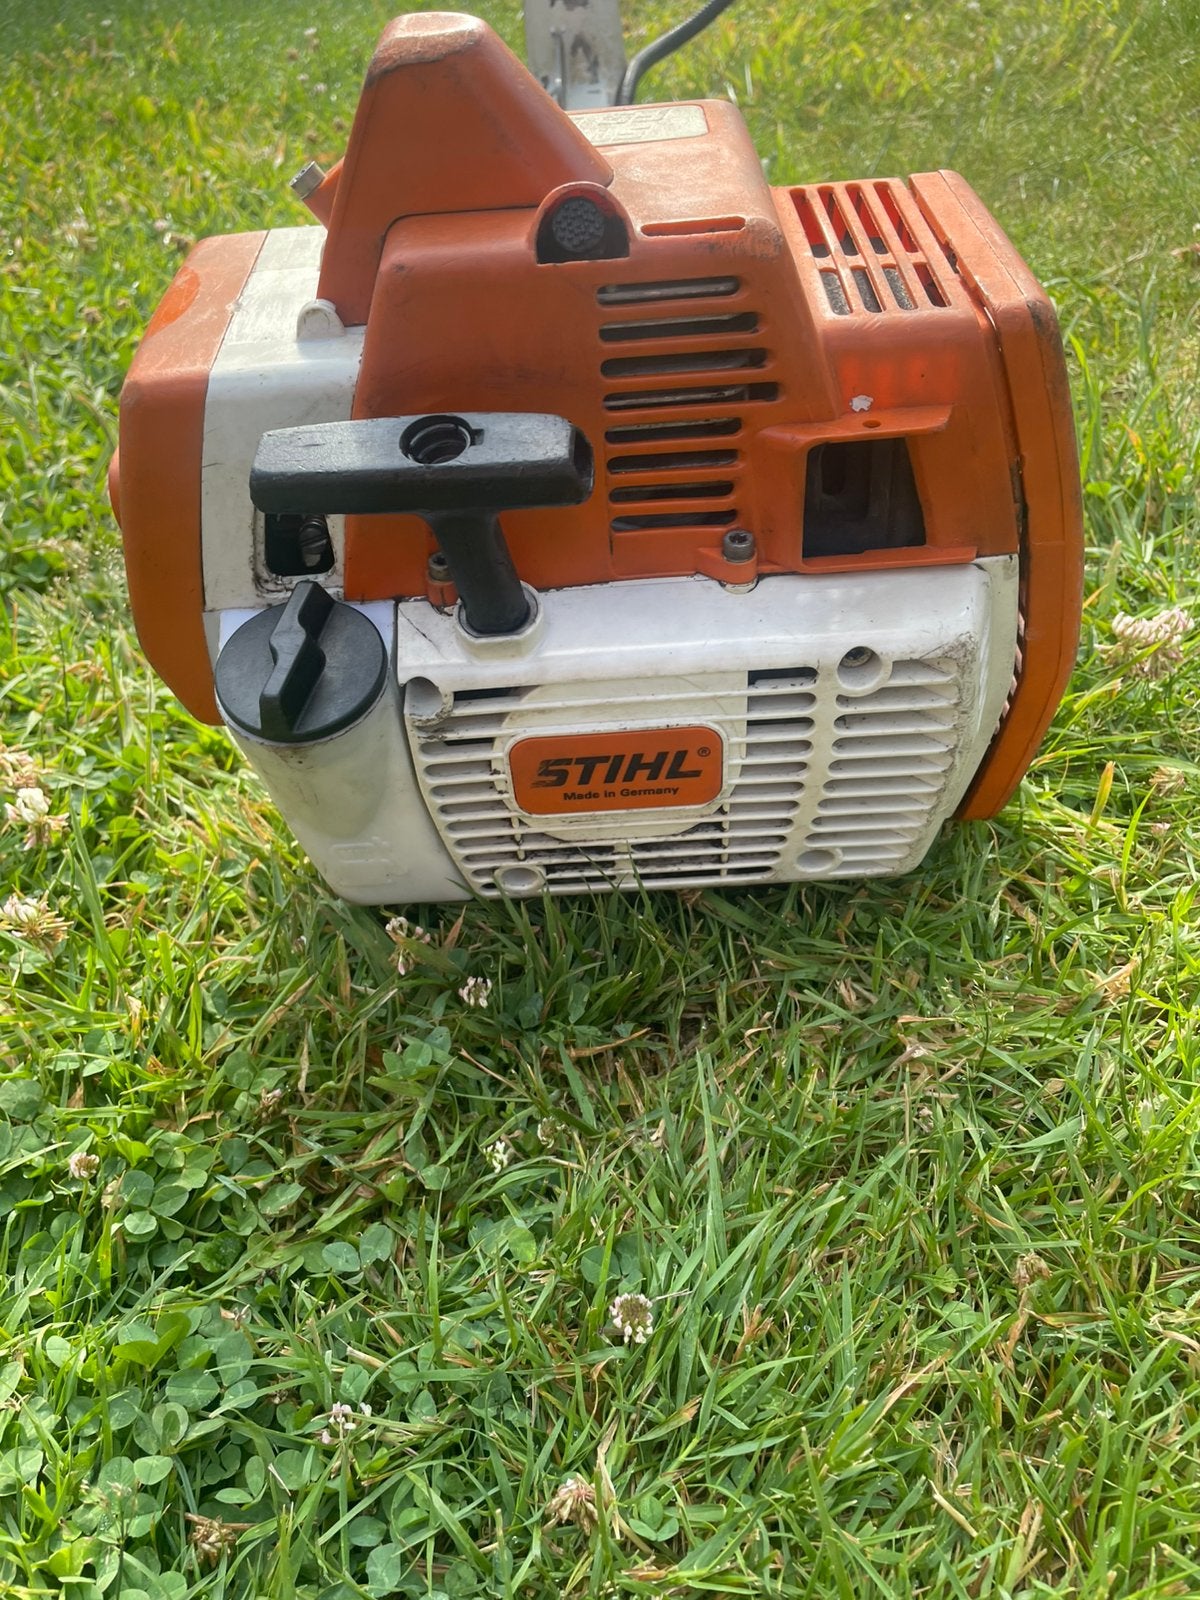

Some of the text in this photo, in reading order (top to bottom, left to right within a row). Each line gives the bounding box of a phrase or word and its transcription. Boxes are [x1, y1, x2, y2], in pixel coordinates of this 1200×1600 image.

[563, 786, 679, 801] Made in Germany
